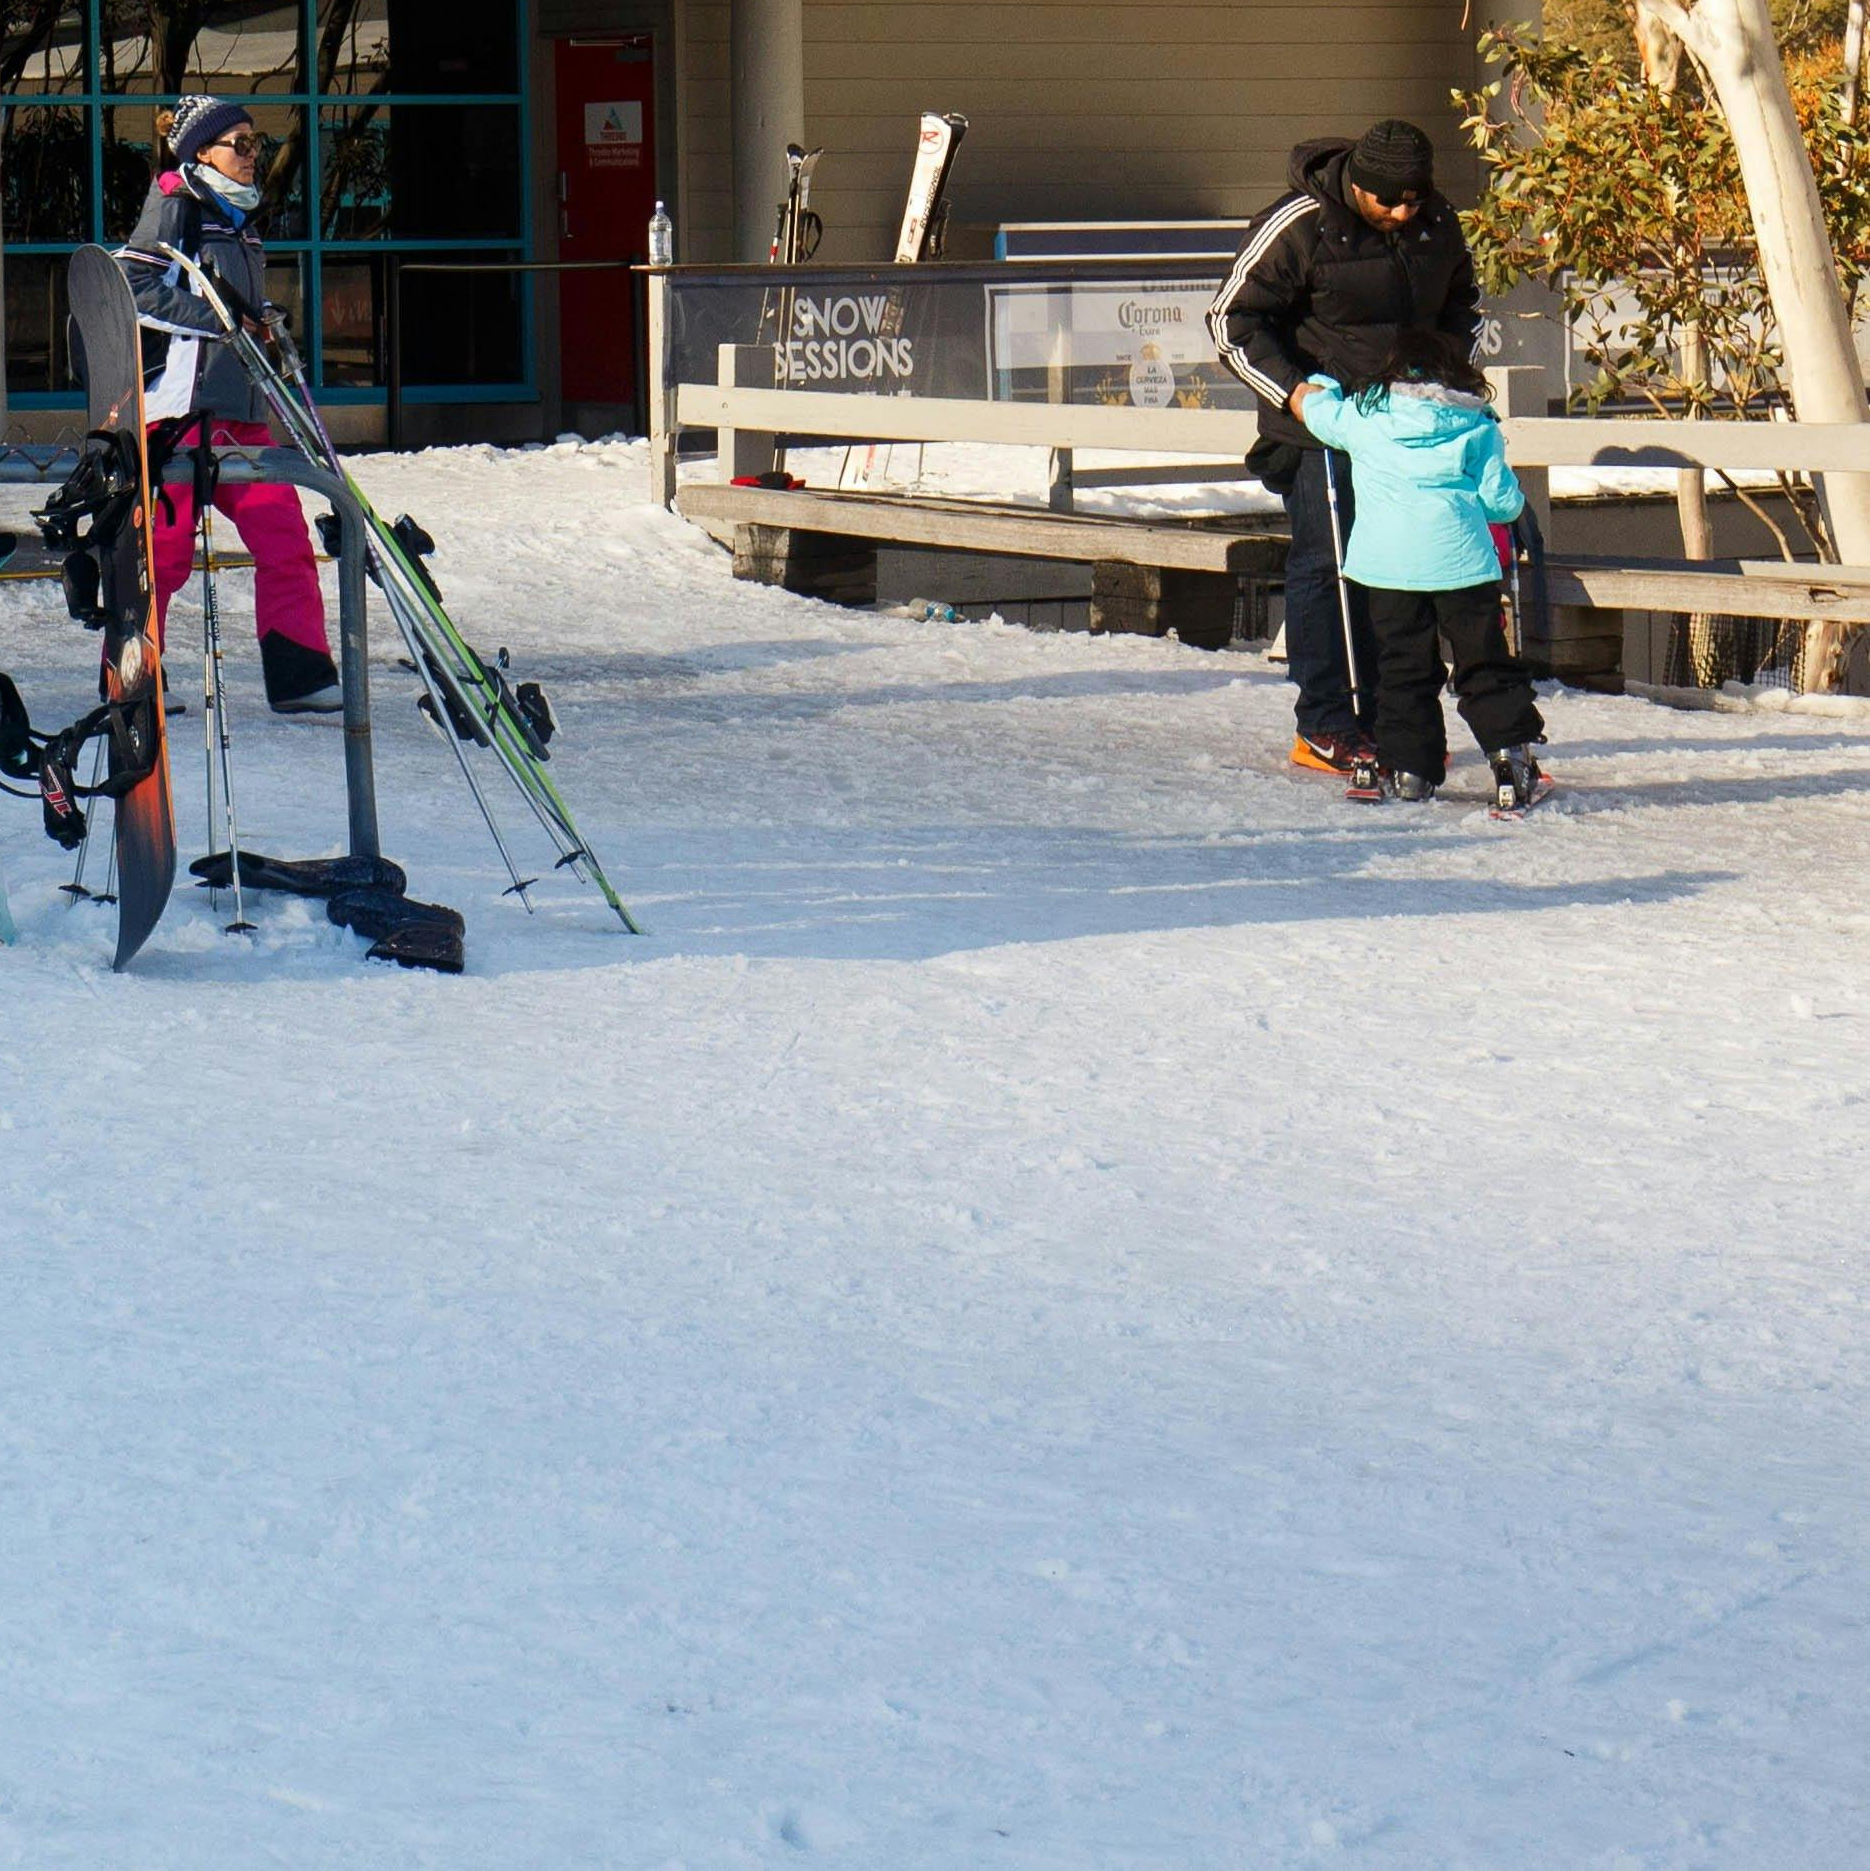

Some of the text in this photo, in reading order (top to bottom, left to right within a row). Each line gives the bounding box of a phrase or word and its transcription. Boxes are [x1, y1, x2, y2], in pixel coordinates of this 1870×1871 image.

[793, 295, 887, 337] SNOW
[1119, 300, 1183, 328] Corona
[775, 338, 914, 380] SESSIONS
